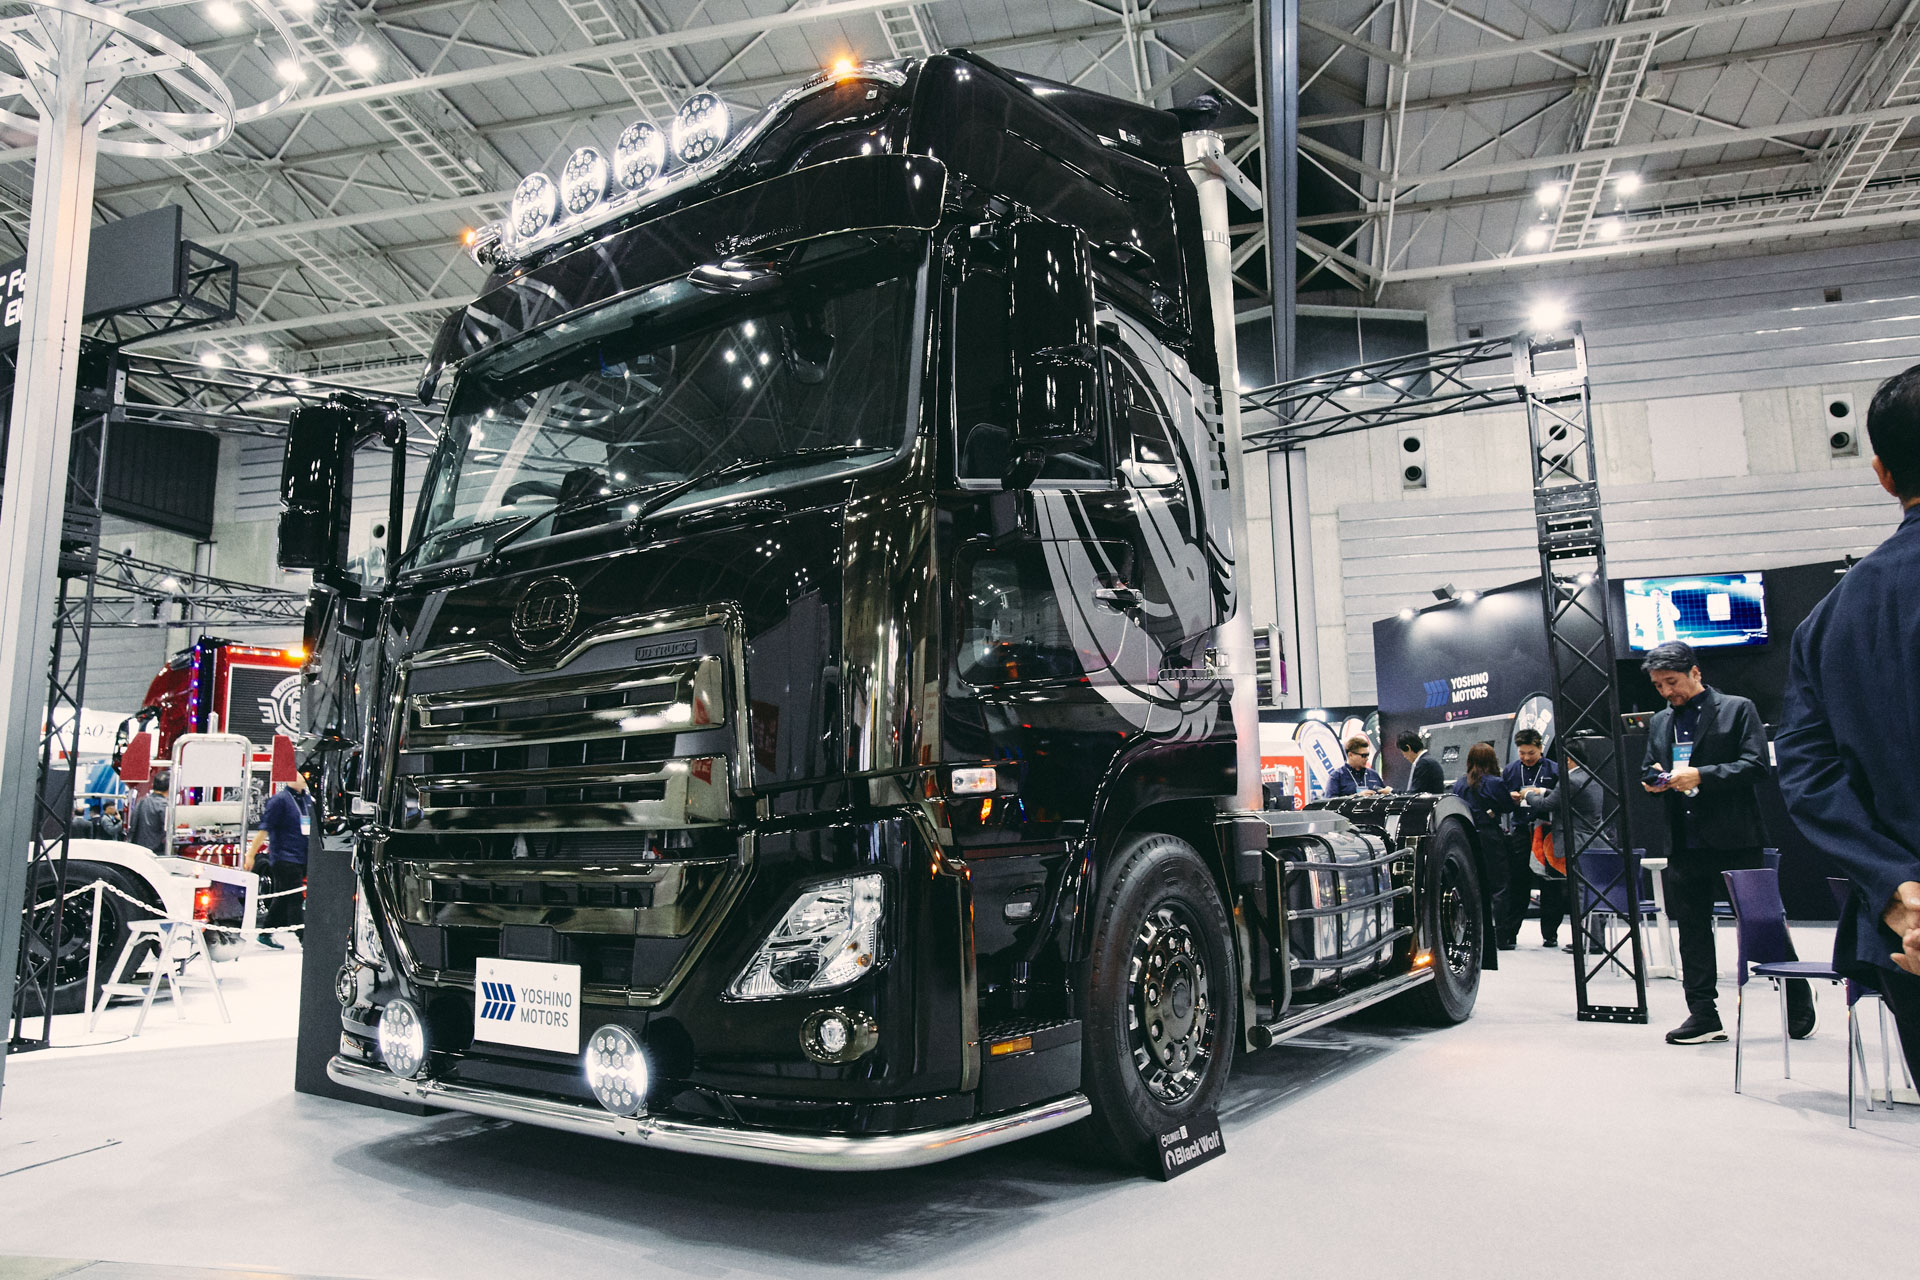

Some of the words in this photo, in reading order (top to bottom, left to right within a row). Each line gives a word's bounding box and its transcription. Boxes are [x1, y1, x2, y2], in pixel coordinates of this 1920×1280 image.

[1450, 671, 1489, 690] YOSHINO
[1451, 685, 1489, 704] MOTORS
[520, 987, 572, 1008] YOSHINO
[520, 1007, 569, 1028] MOTORS
[1174, 1140, 1202, 1165] Black
[1198, 1130, 1221, 1153] Wolf
